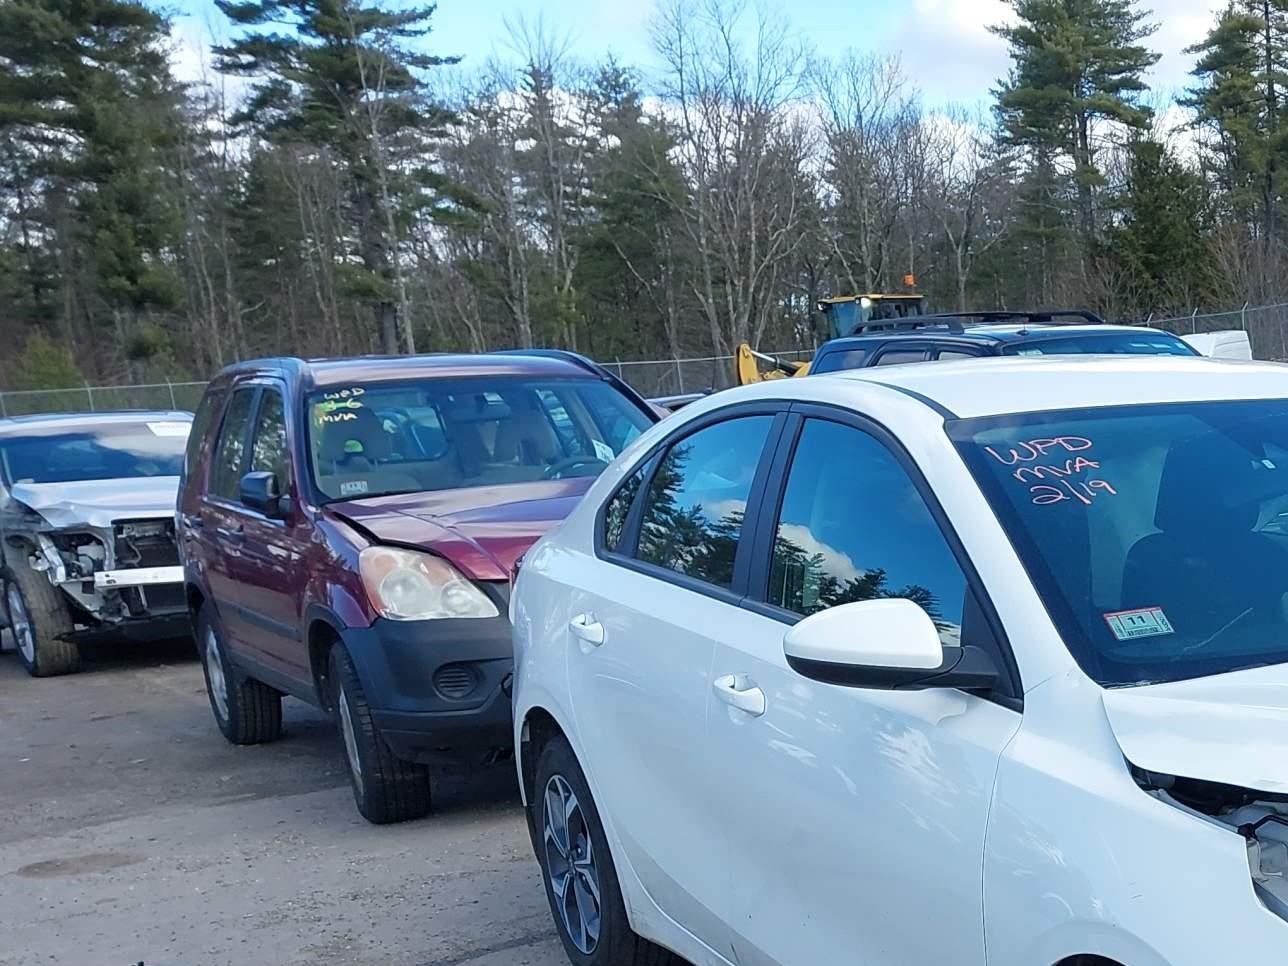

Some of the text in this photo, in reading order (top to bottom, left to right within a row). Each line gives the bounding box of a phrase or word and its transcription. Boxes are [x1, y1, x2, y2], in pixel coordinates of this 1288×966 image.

[984, 436, 1093, 465] WPD
[1012, 456, 1100, 483] MVA
[1030, 479, 1117, 504] 2/19
[1127, 615, 1146, 626] 11
